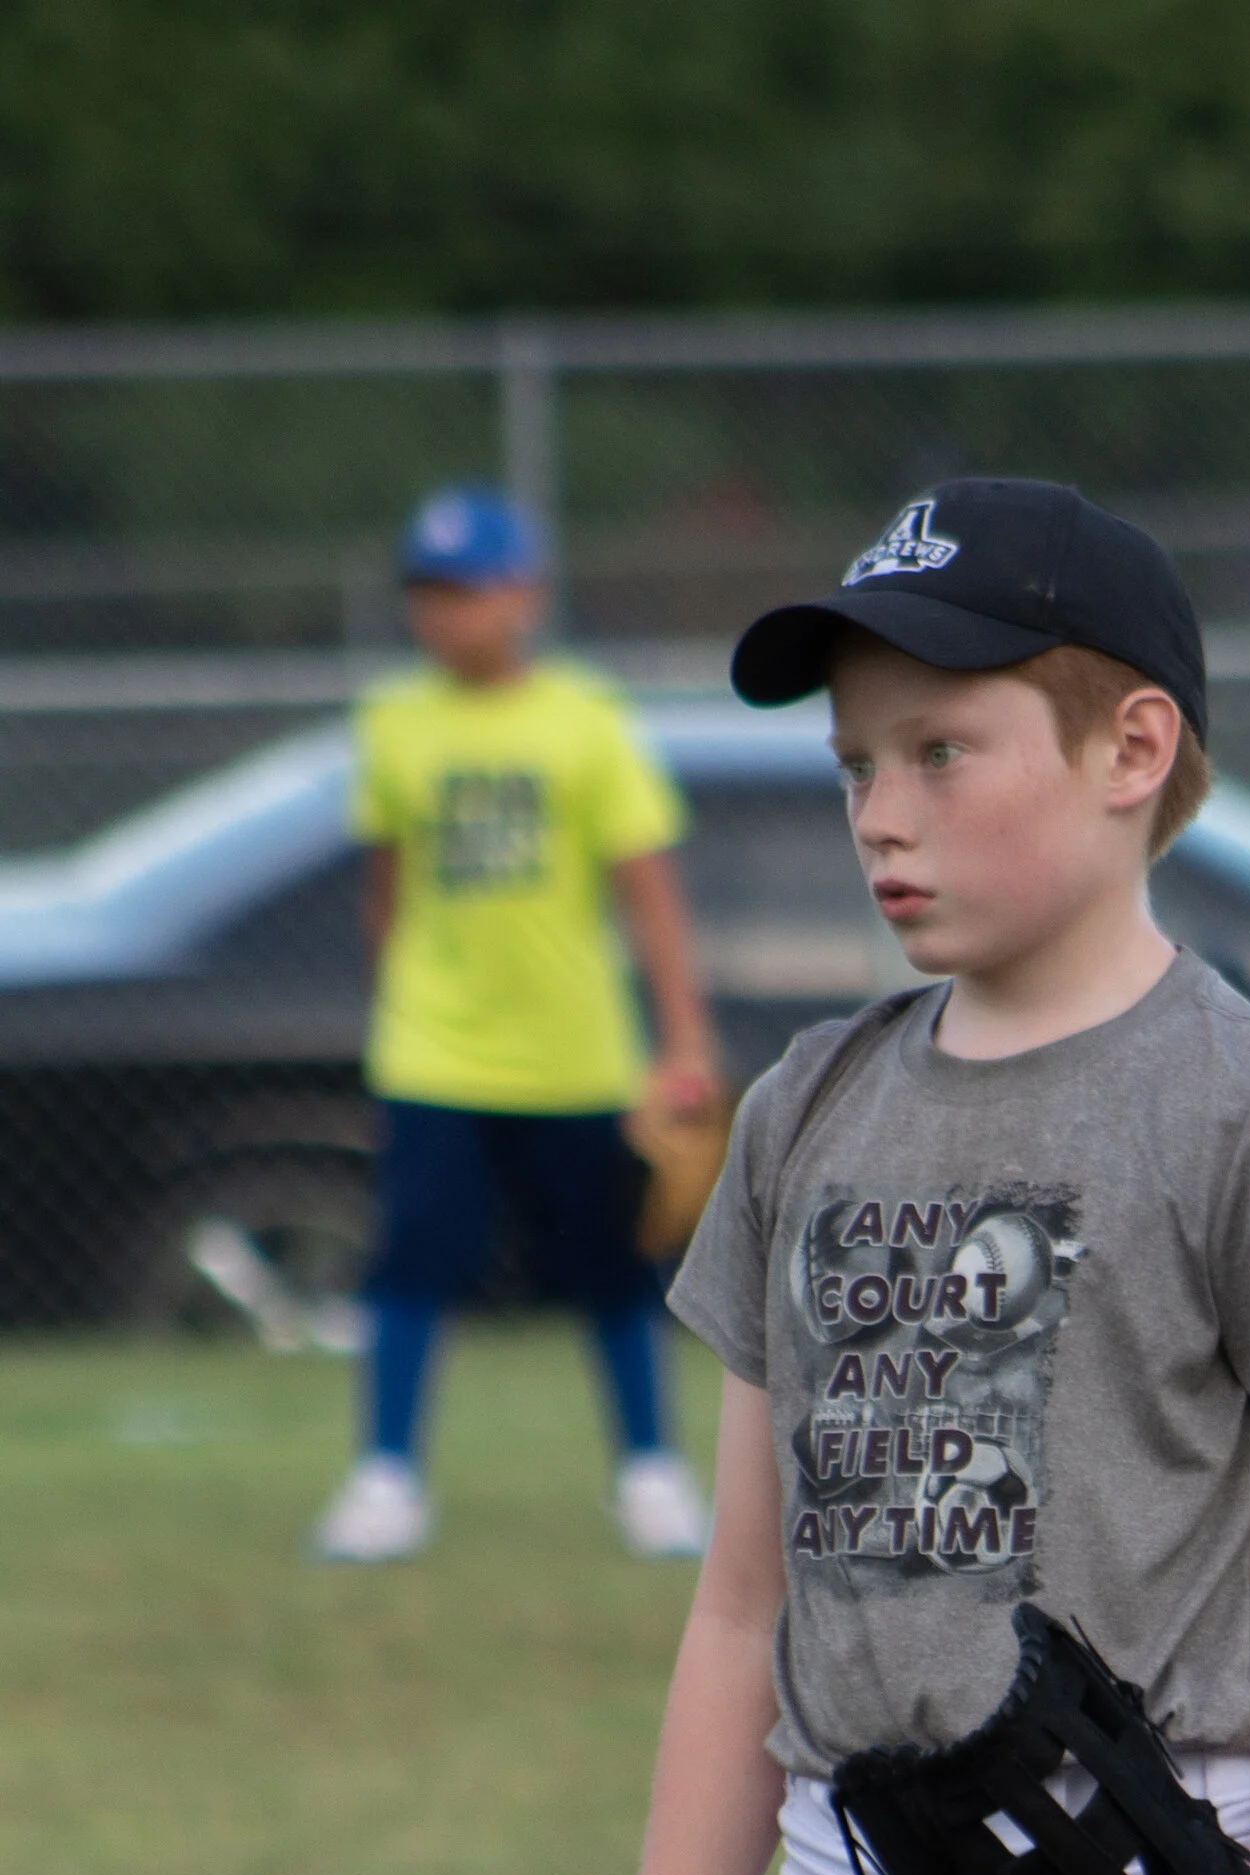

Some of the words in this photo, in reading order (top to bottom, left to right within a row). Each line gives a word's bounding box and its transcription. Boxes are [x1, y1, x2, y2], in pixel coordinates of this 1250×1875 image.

[840, 1200, 979, 1249] ANY
[815, 1272, 1007, 1325] COURT
[826, 1350, 960, 1400] ANY
[818, 1428, 975, 1479] FIELD
